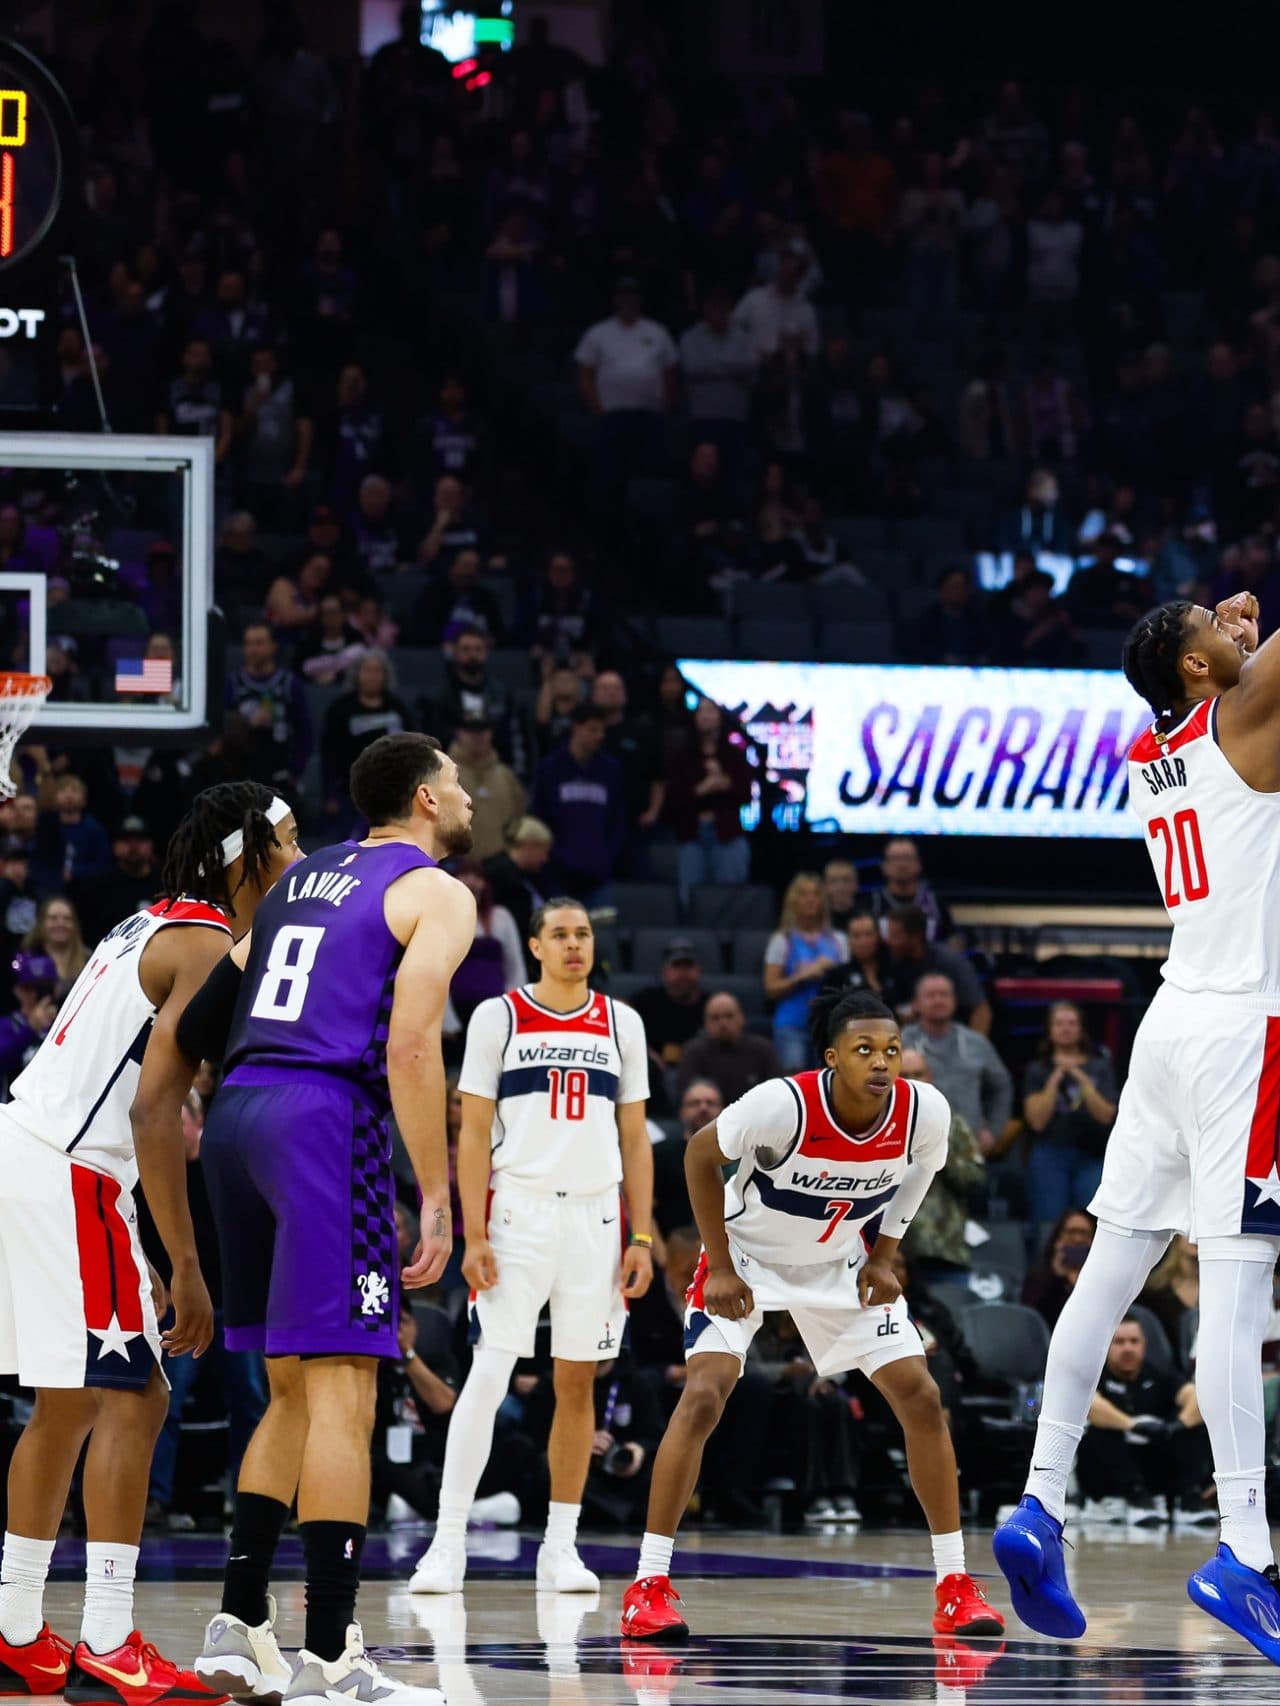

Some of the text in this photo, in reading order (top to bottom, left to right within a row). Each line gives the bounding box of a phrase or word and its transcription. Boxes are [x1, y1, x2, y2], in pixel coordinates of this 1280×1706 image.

[1142, 757, 1187, 796] SARR
[1148, 808, 1209, 908] 20
[287, 871, 361, 907] LAVINE
[251, 925, 326, 1022] 8
[518, 1042, 609, 1065] wizards
[548, 1069, 587, 1121] 18
[791, 1169, 896, 1191] wizards
[816, 1200, 853, 1243] 7
